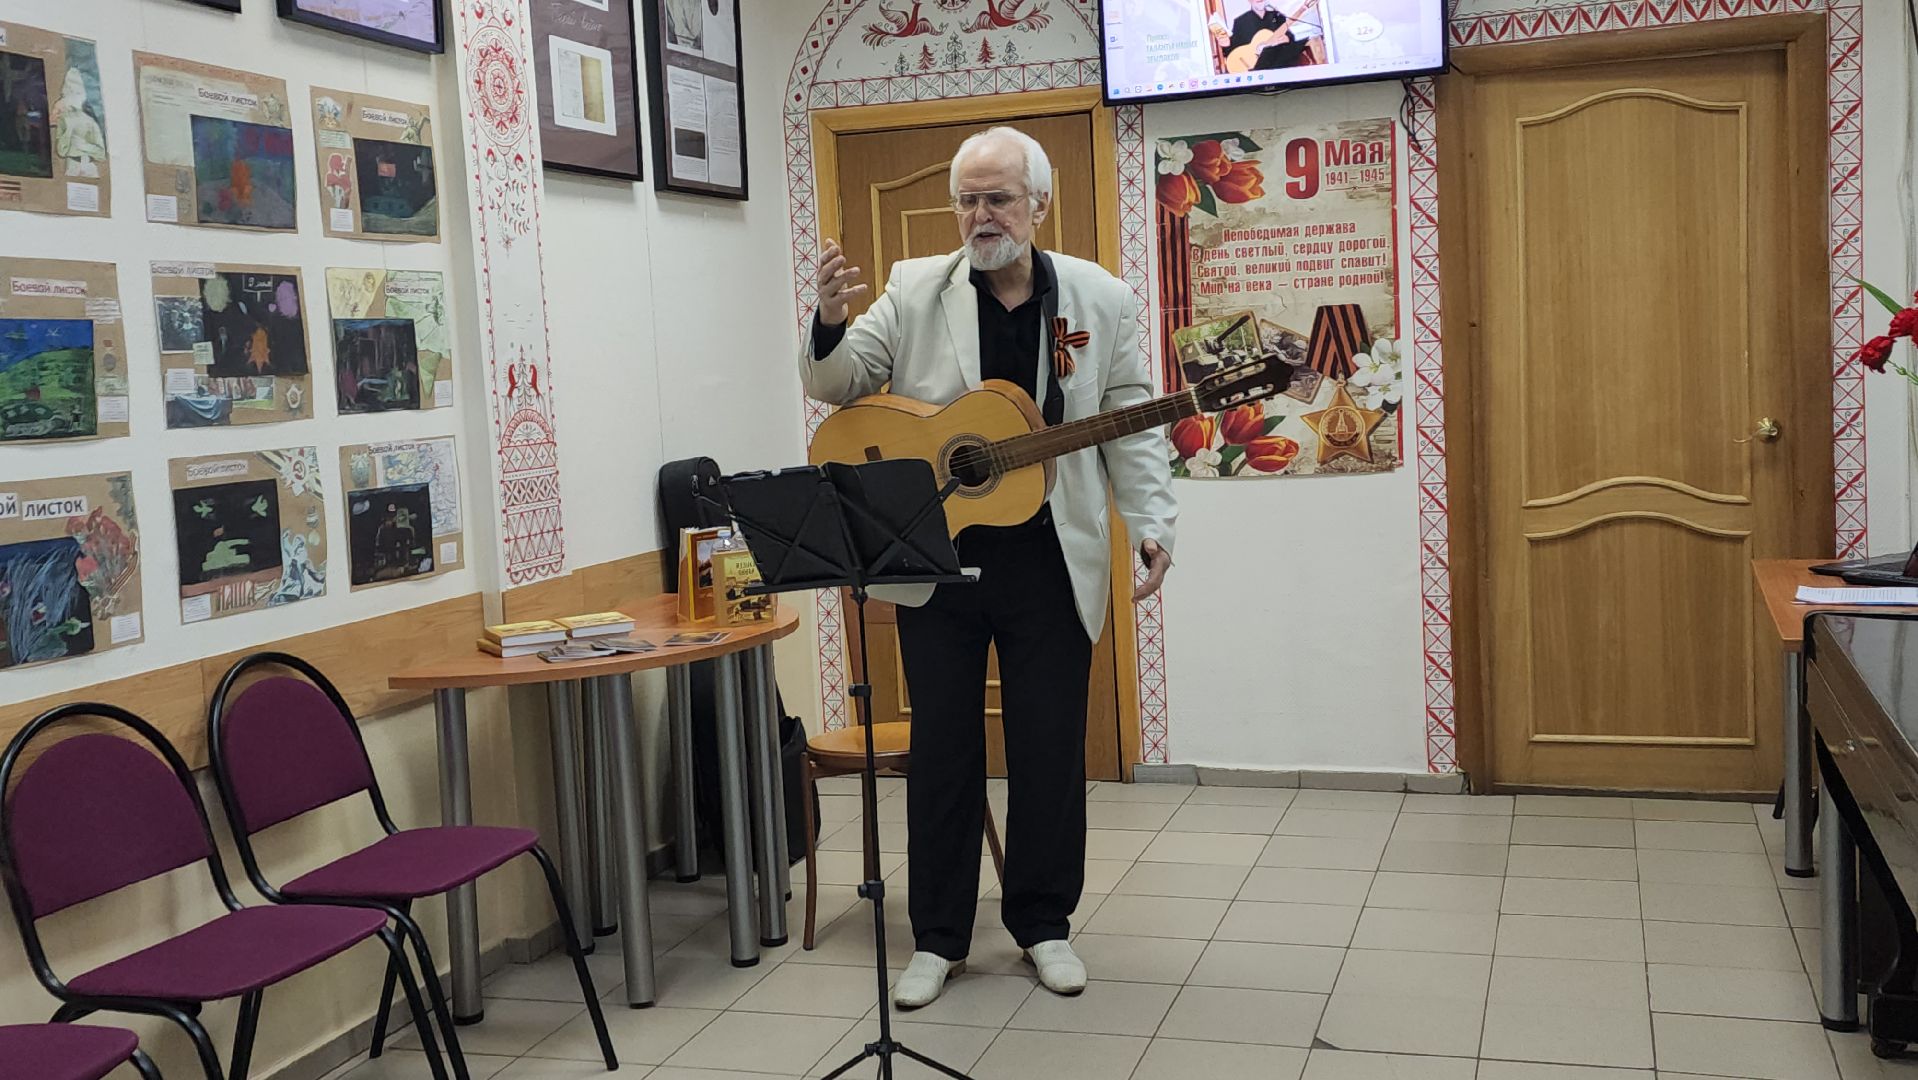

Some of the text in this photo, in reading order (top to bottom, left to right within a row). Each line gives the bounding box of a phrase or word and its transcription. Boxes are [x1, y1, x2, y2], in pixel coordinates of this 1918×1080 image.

[1285, 137, 1384, 200] 9 Мая
[1223, 222, 1356, 243] Непобедимая держава
[1192, 248, 1200, 262] В
[1203, 248, 1231, 263] день
[1235, 242, 1288, 259] светлый,
[1293, 241, 1333, 256] сердцу
[1245, 258, 1291, 275] великий
[1296, 258, 1335, 273] подвиг
[1200, 281, 1224, 296] Мир
[1227, 281, 1241, 294] на
[1245, 280, 1272, 292] века
[1293, 275, 1334, 291] стране
[1338, 269, 1385, 288] родной!
